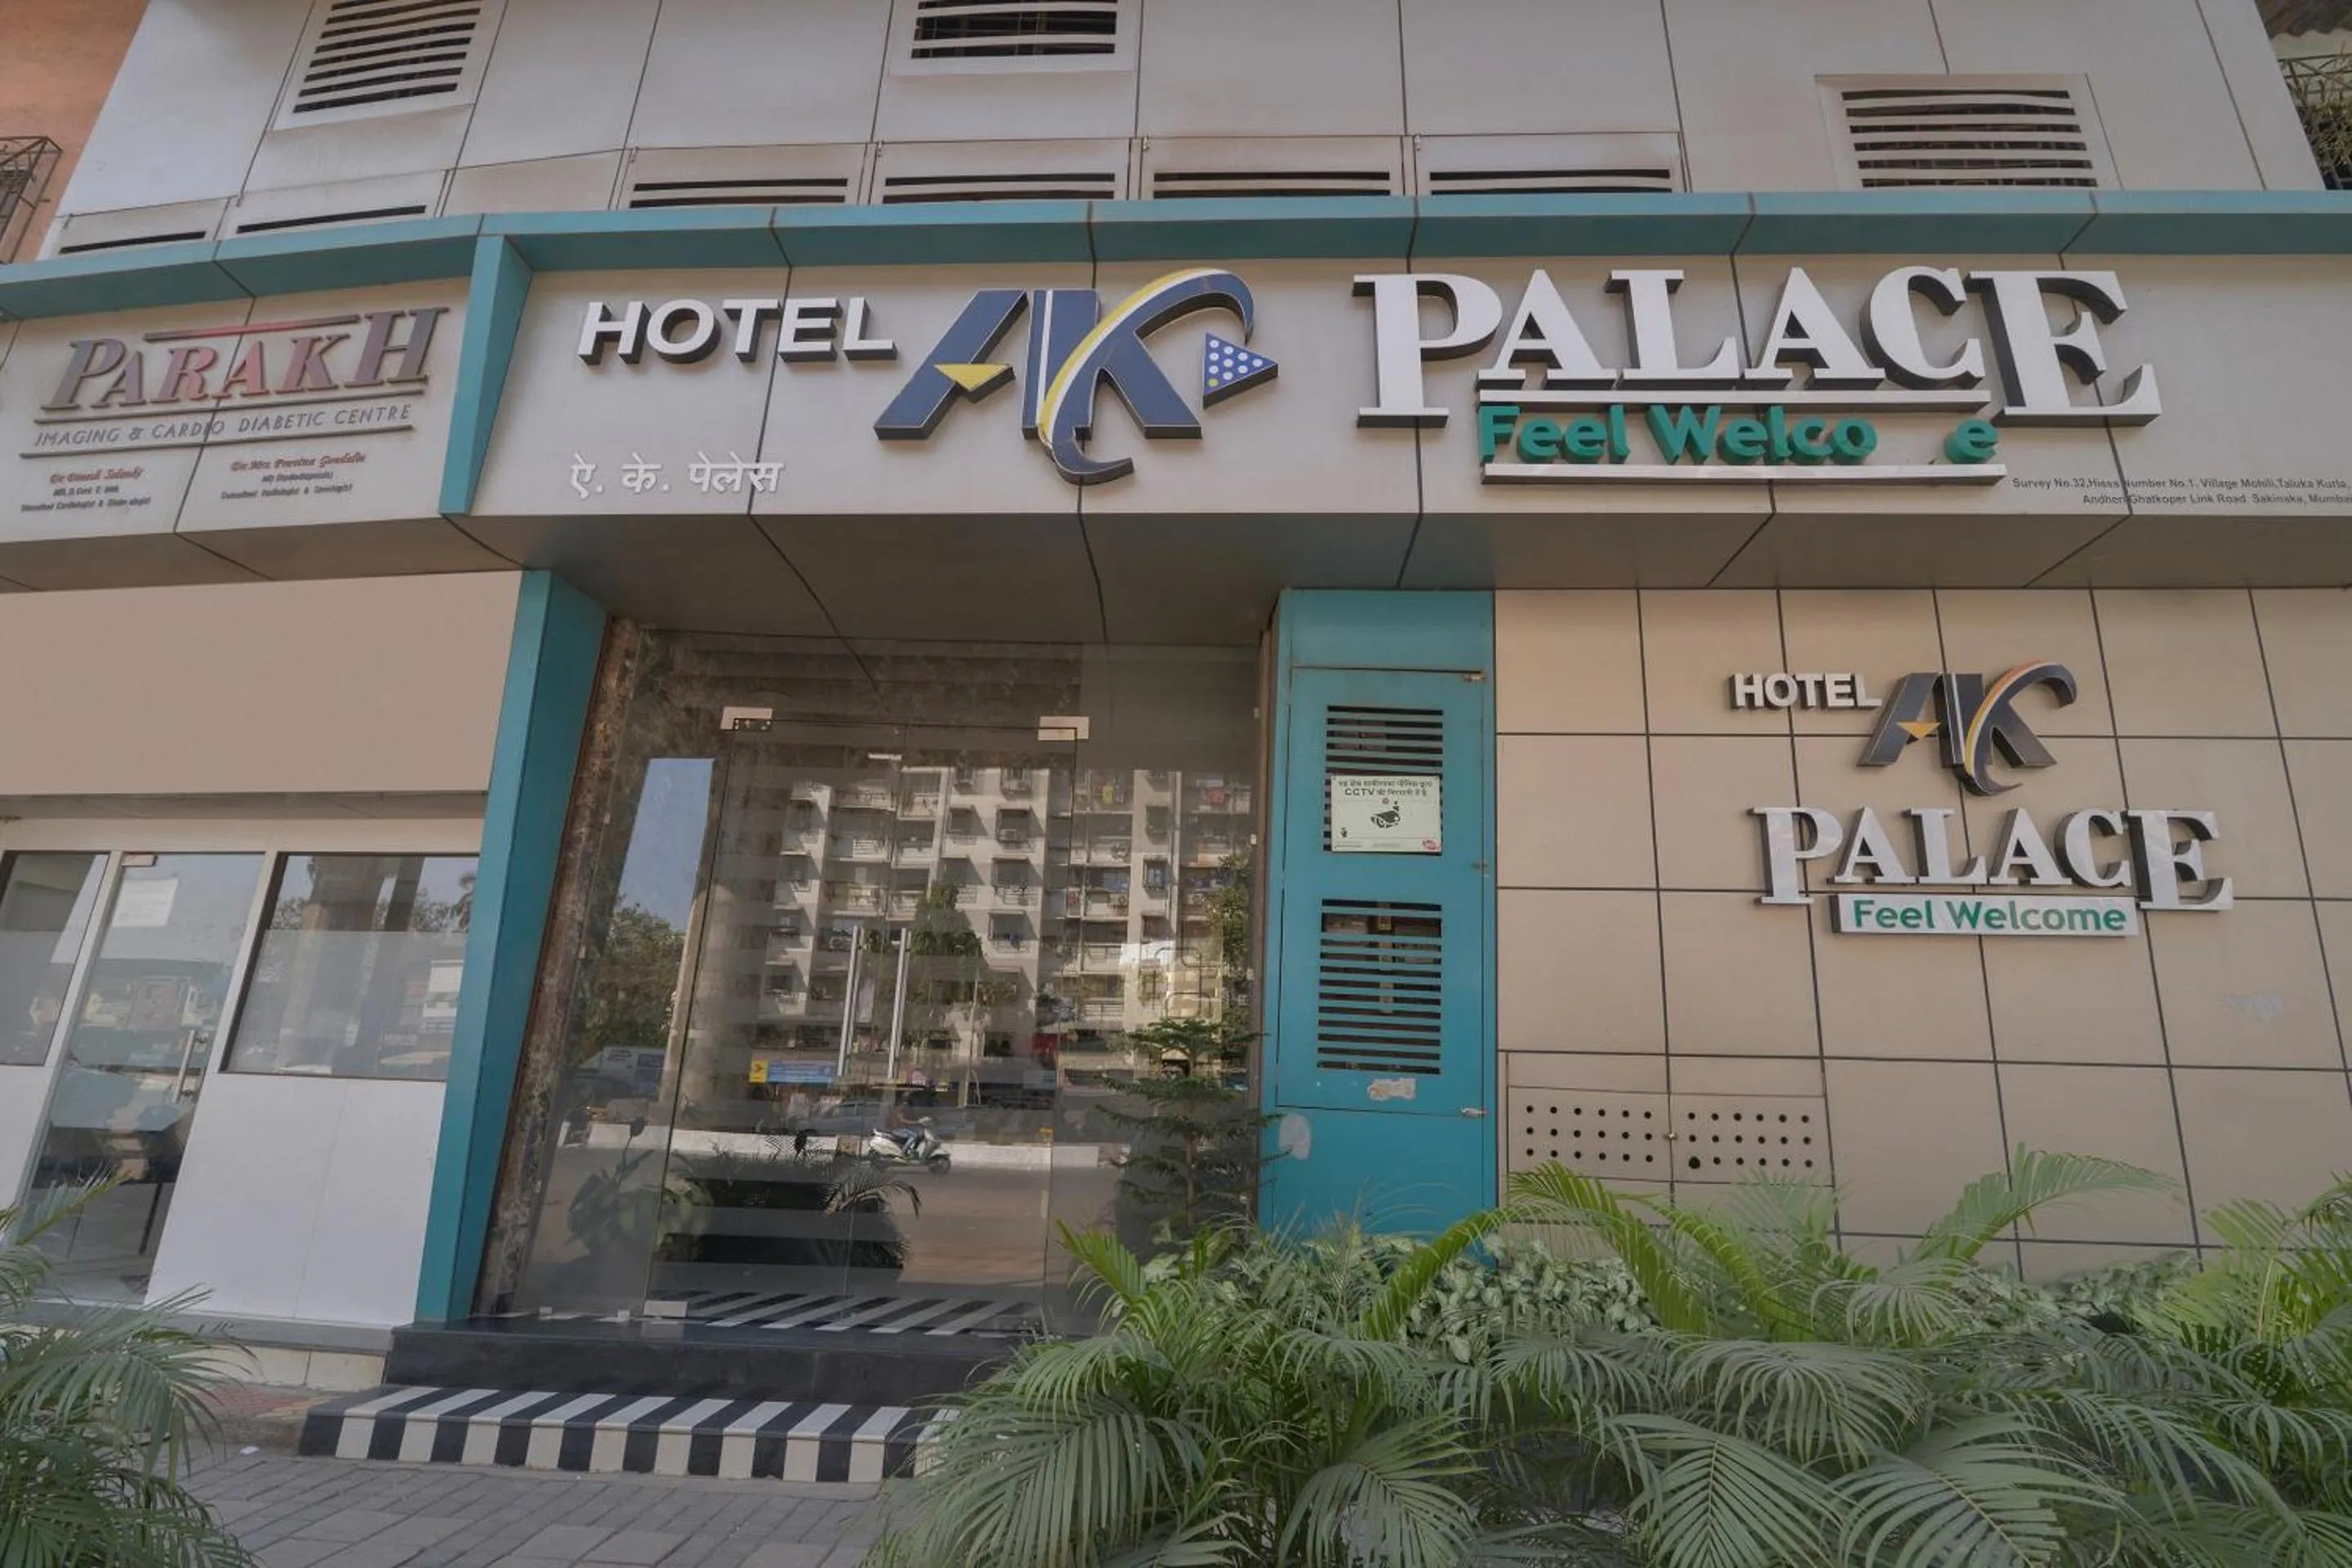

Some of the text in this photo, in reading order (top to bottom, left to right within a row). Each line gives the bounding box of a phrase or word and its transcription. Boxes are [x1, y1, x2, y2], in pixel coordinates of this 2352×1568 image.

[577, 296, 898, 365] HOTEL
[1352, 265, 2162, 428] PALACE
[40, 307, 449, 411] PARAKH
[34, 404, 412, 447] IMAGING & CARDIO DIABETIC CENTRE
[1478, 403, 2000, 466] Feel Welcoe
[687, 451, 785, 492] पेलेस
[2012, 478, 2051, 489] Survey
[1731, 673, 1882, 709] HOTEL
[1344, 787, 1375, 796] CCTV
[1748, 807, 2234, 911] PALACE
[1853, 899, 2127, 931] Feel Welcome
